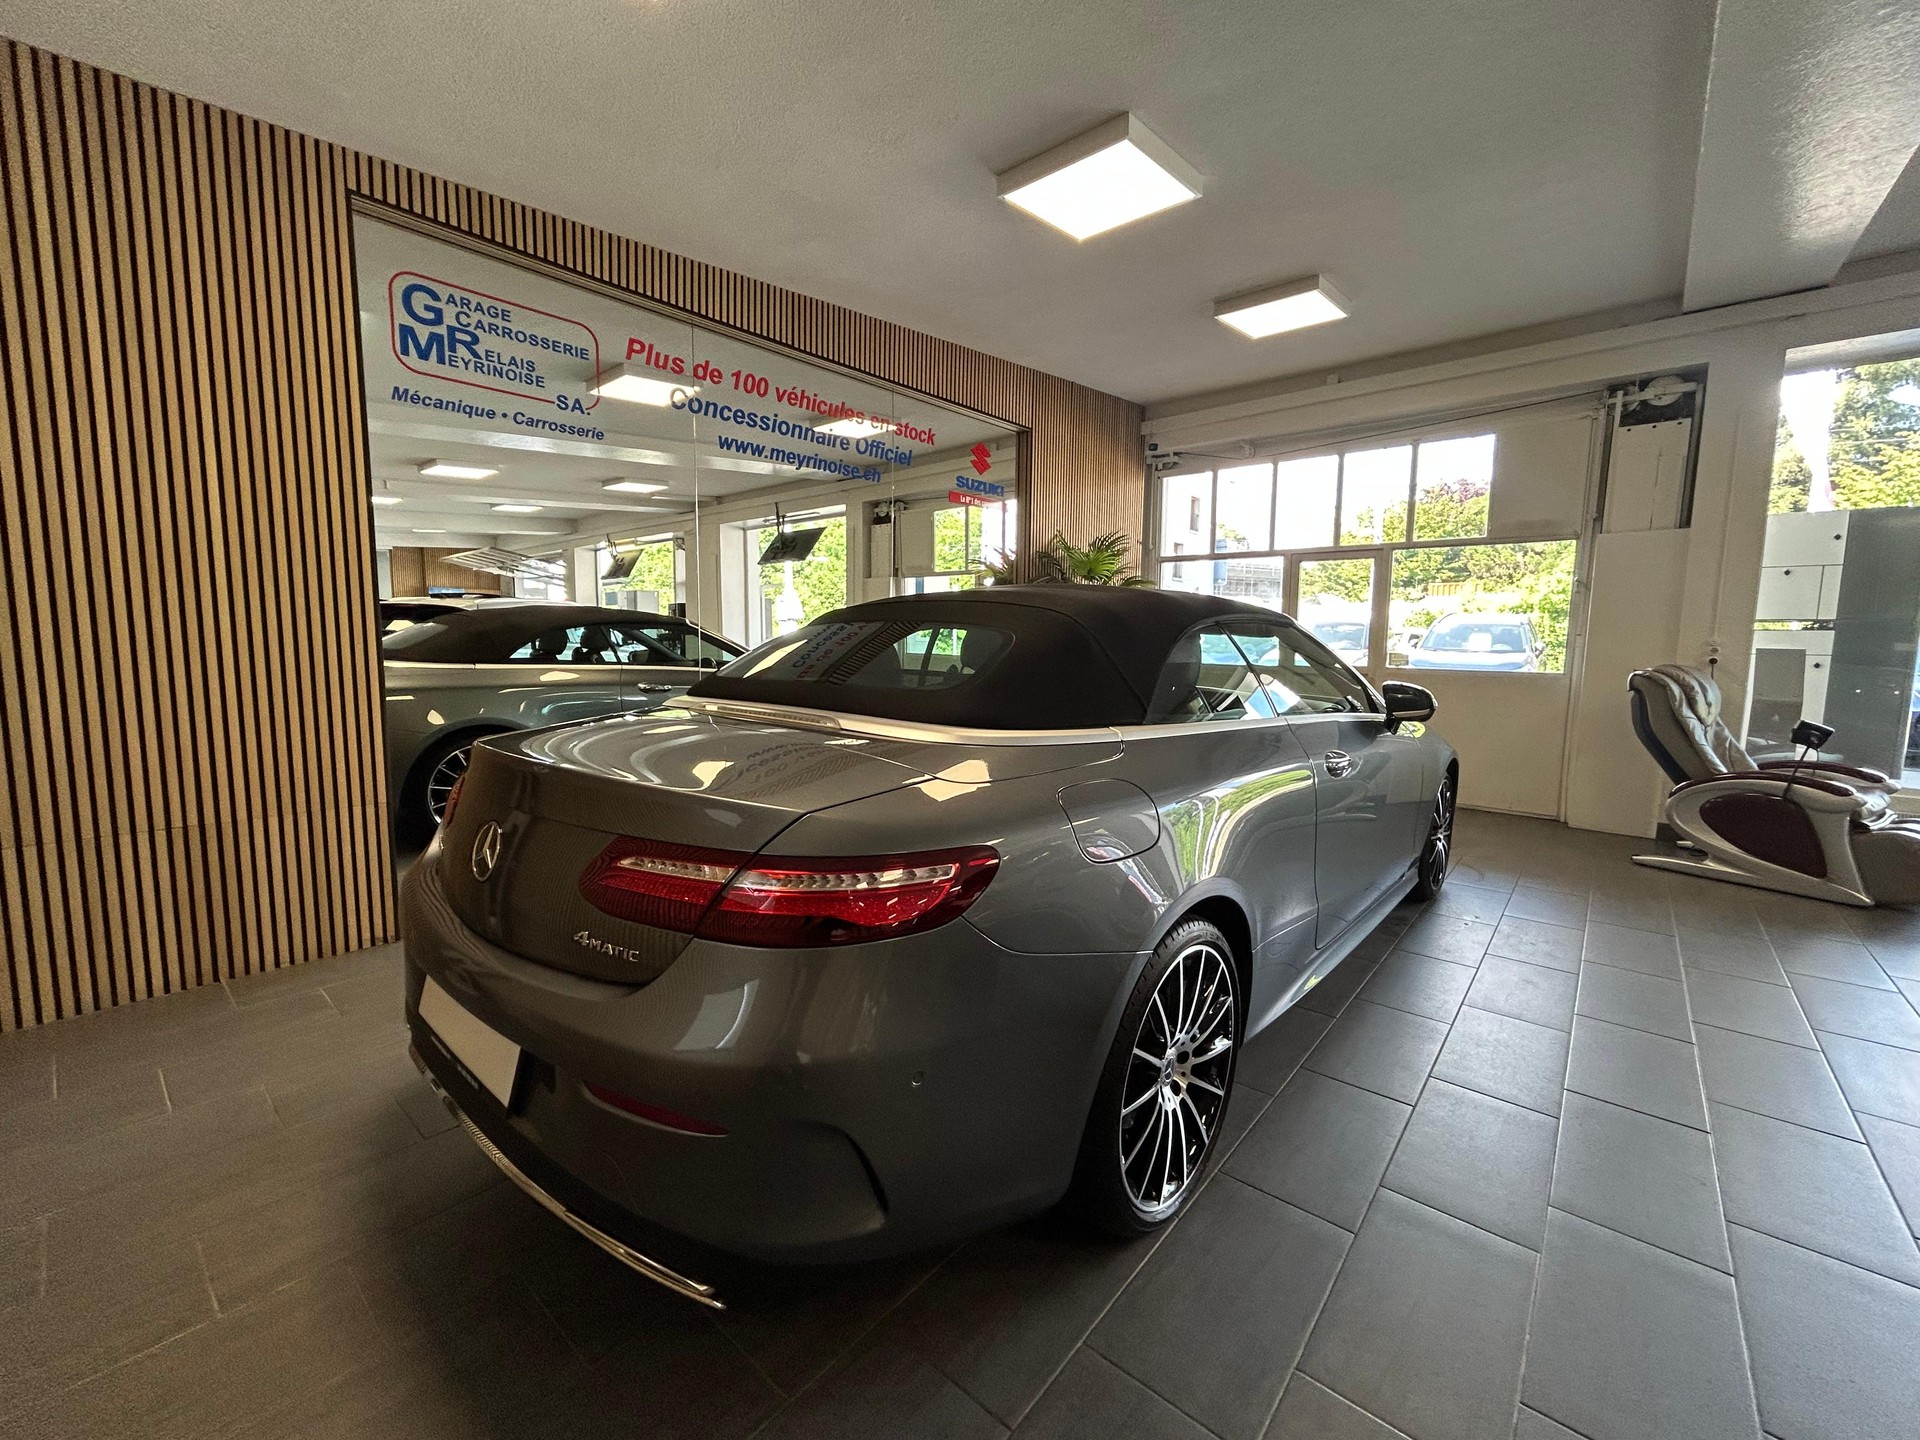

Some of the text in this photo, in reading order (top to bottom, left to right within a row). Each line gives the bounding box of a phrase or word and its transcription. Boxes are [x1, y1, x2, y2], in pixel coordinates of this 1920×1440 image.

[455, 311, 590, 360] CARROSSERIE
[391, 386, 605, 440] Mécanique Carrosserie
[556, 394, 591, 416] SA.
[625, 337, 937, 446] Plus de 100 véhicules en stock
[670, 387, 913, 467] Concessionnaire Officiel
[956, 475, 1005, 497] SUZUKI
[573, 931, 640, 962] 4MATIC
